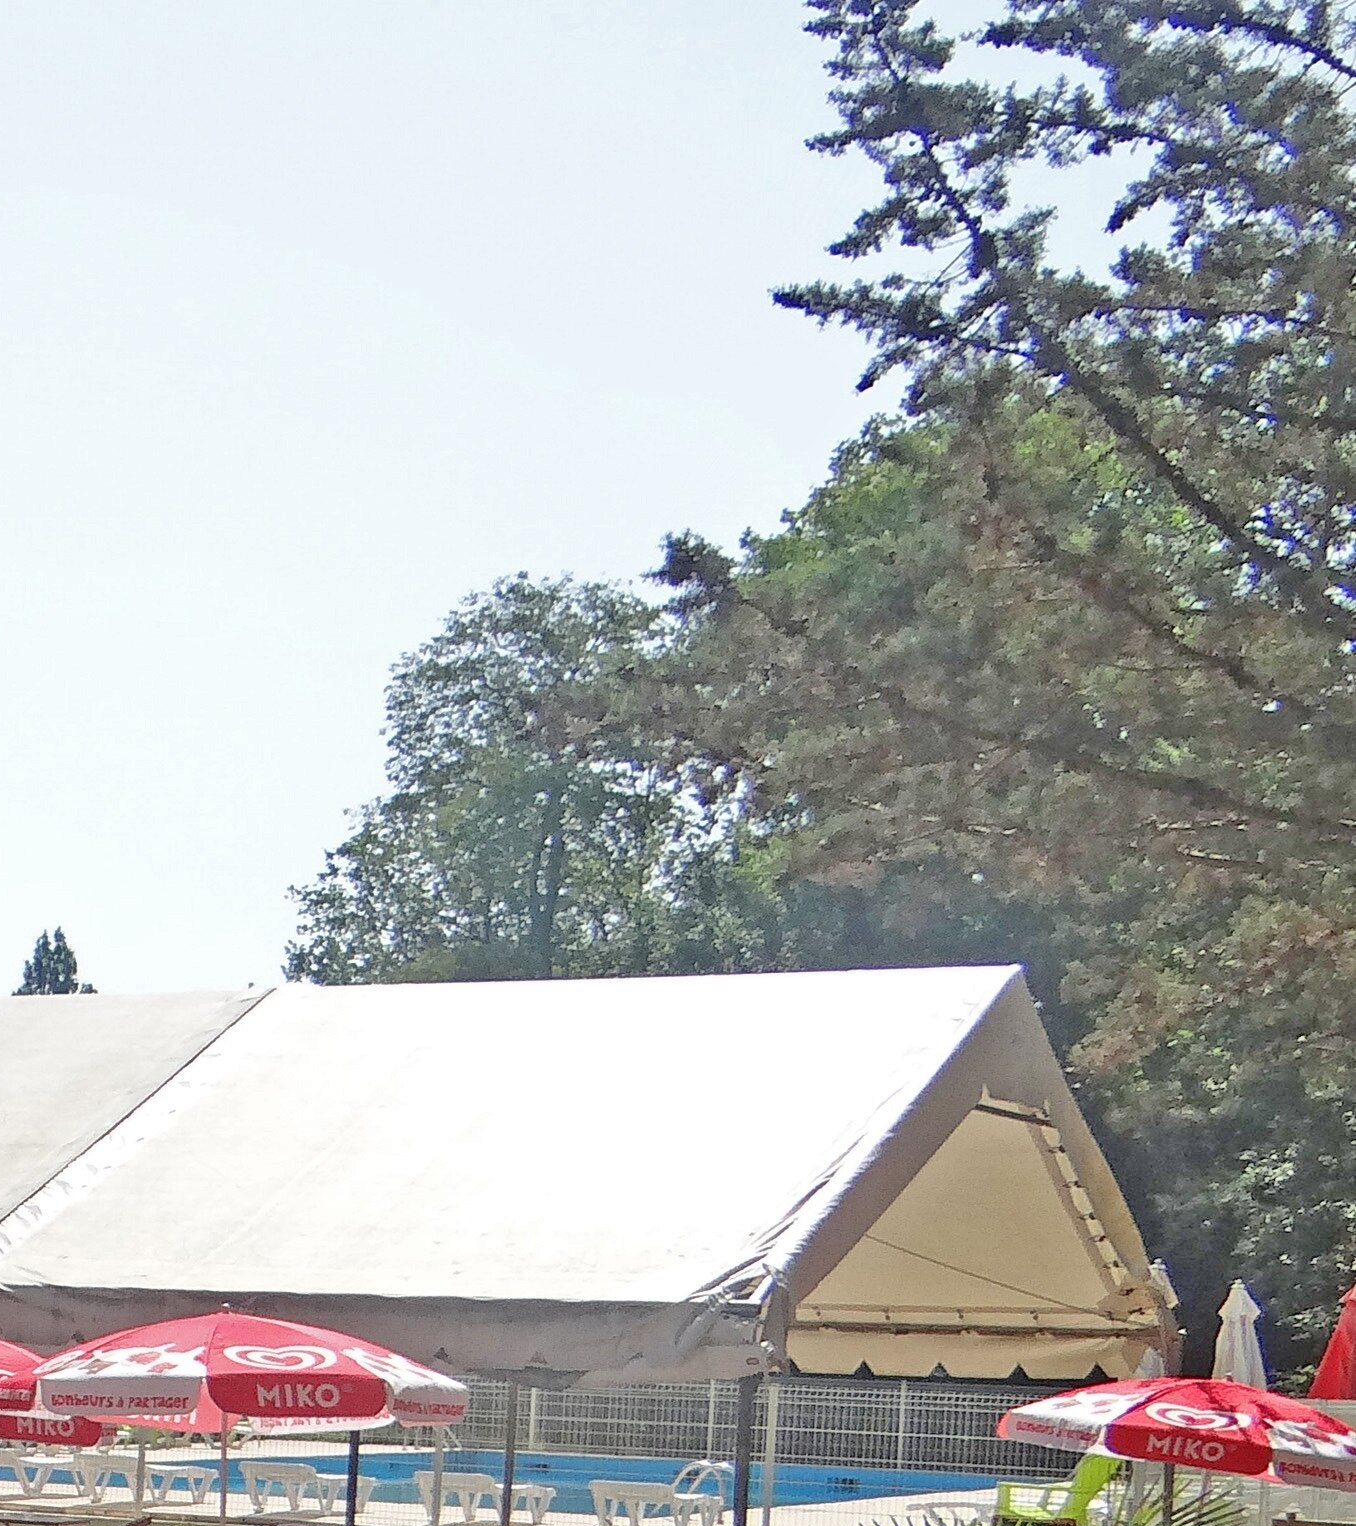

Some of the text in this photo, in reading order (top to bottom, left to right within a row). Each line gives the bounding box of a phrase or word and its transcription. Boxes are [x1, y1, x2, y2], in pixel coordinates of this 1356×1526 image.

[256, 1383, 341, 1408] MIKO
[16, 1418, 75, 1437] MIKO
[1146, 1433, 1226, 1462] MIKO
